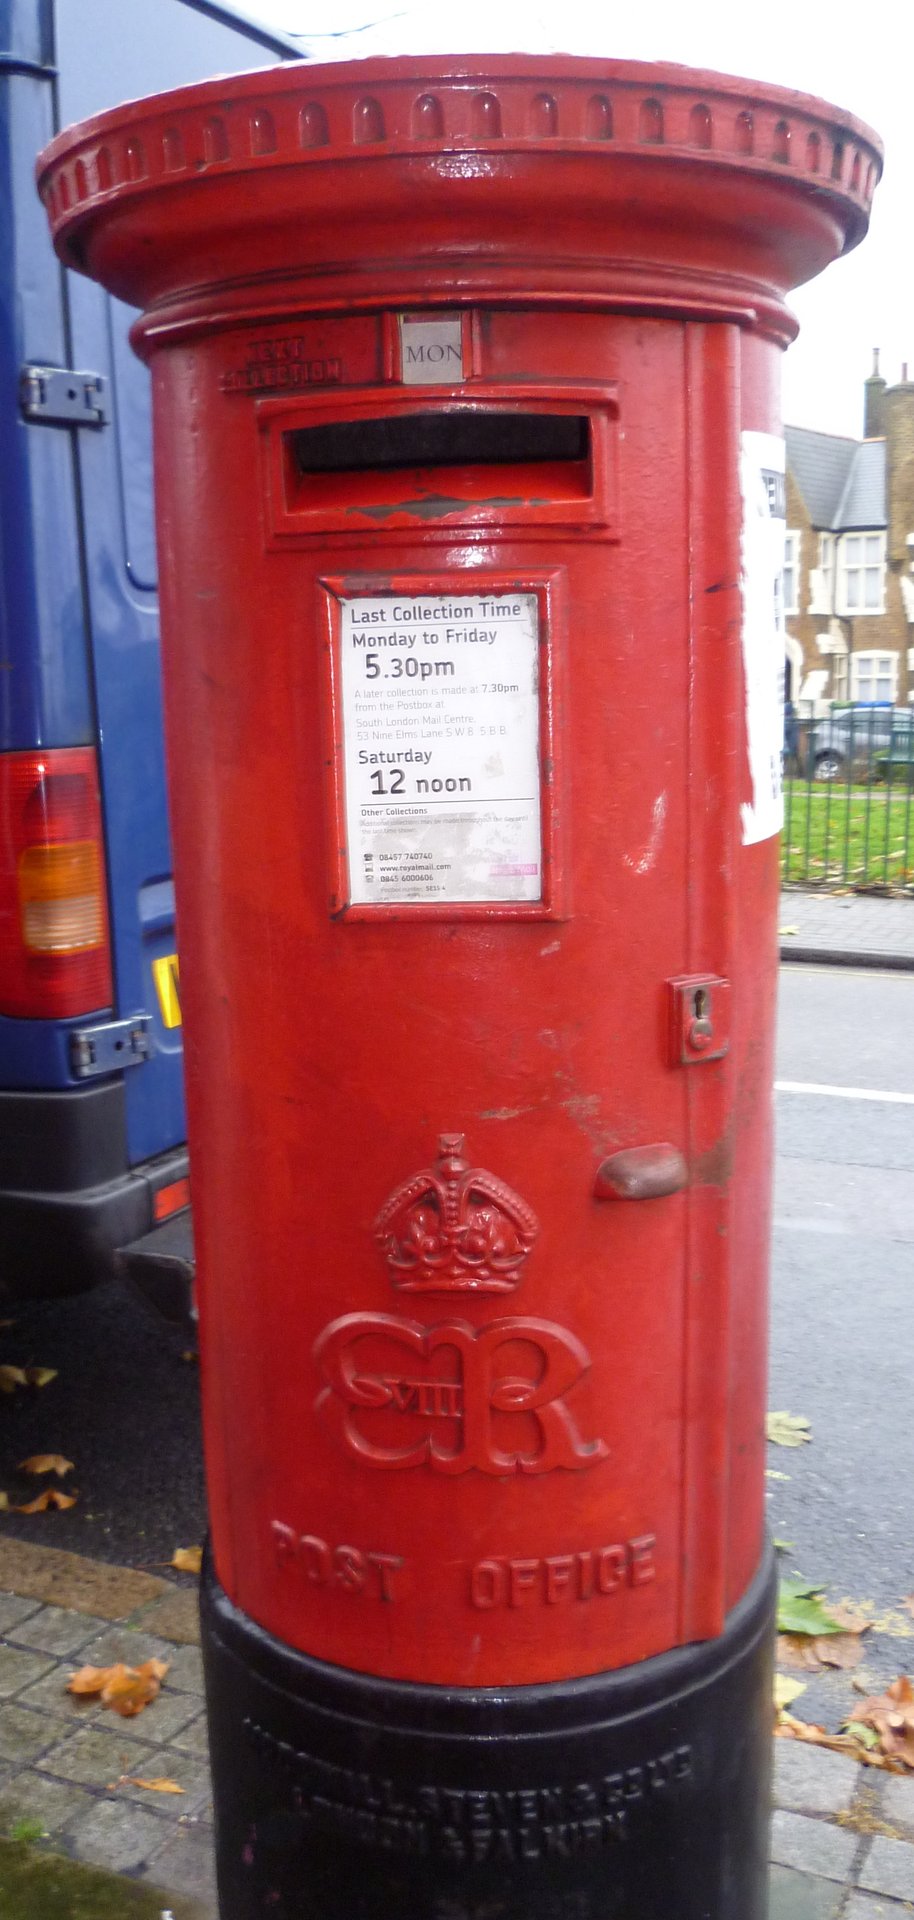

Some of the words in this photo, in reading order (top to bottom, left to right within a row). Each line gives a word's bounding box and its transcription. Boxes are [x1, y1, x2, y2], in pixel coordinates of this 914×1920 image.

[406, 344, 463, 363] MON
[351, 608, 386, 624] Last
[393, 604, 473, 622] Collection
[479, 602, 521, 617] Time
[352, 632, 416, 649] Monday
[423, 631, 439, 645] to
[446, 628, 497, 646] Friday
[365, 653, 455, 681] 5.30pm
[354, 689, 361, 699] A
[363, 688, 383, 699] later
[387, 687, 429, 698] collection
[431, 687, 439, 696] is
[441, 685, 467, 695] made
[470, 684, 479, 694] at
[481, 683, 519, 695] 7.30pm
[355, 702, 376, 712] from
[379, 702, 394, 711] the
[397, 701, 433, 711] Postbox
[435, 701, 445, 710] at
[355, 718, 383, 728] South
[386, 717, 419, 727] London
[422, 716, 441, 726] Mail
[357, 731, 369, 741] 53
[372, 730, 393, 740] Nine
[396, 729, 418, 739] Elms
[421, 728, 443, 738] Lane
[358, 749, 433, 765] Saturday
[369, 769, 406, 795] 12
[416, 777, 472, 793] noon
[380, 863, 451, 872] www.royalmail.com
[384, 1378, 463, 1418] VIII
[271, 1519, 405, 1603] POST
[471, 1531, 657, 1610] OFFICE
